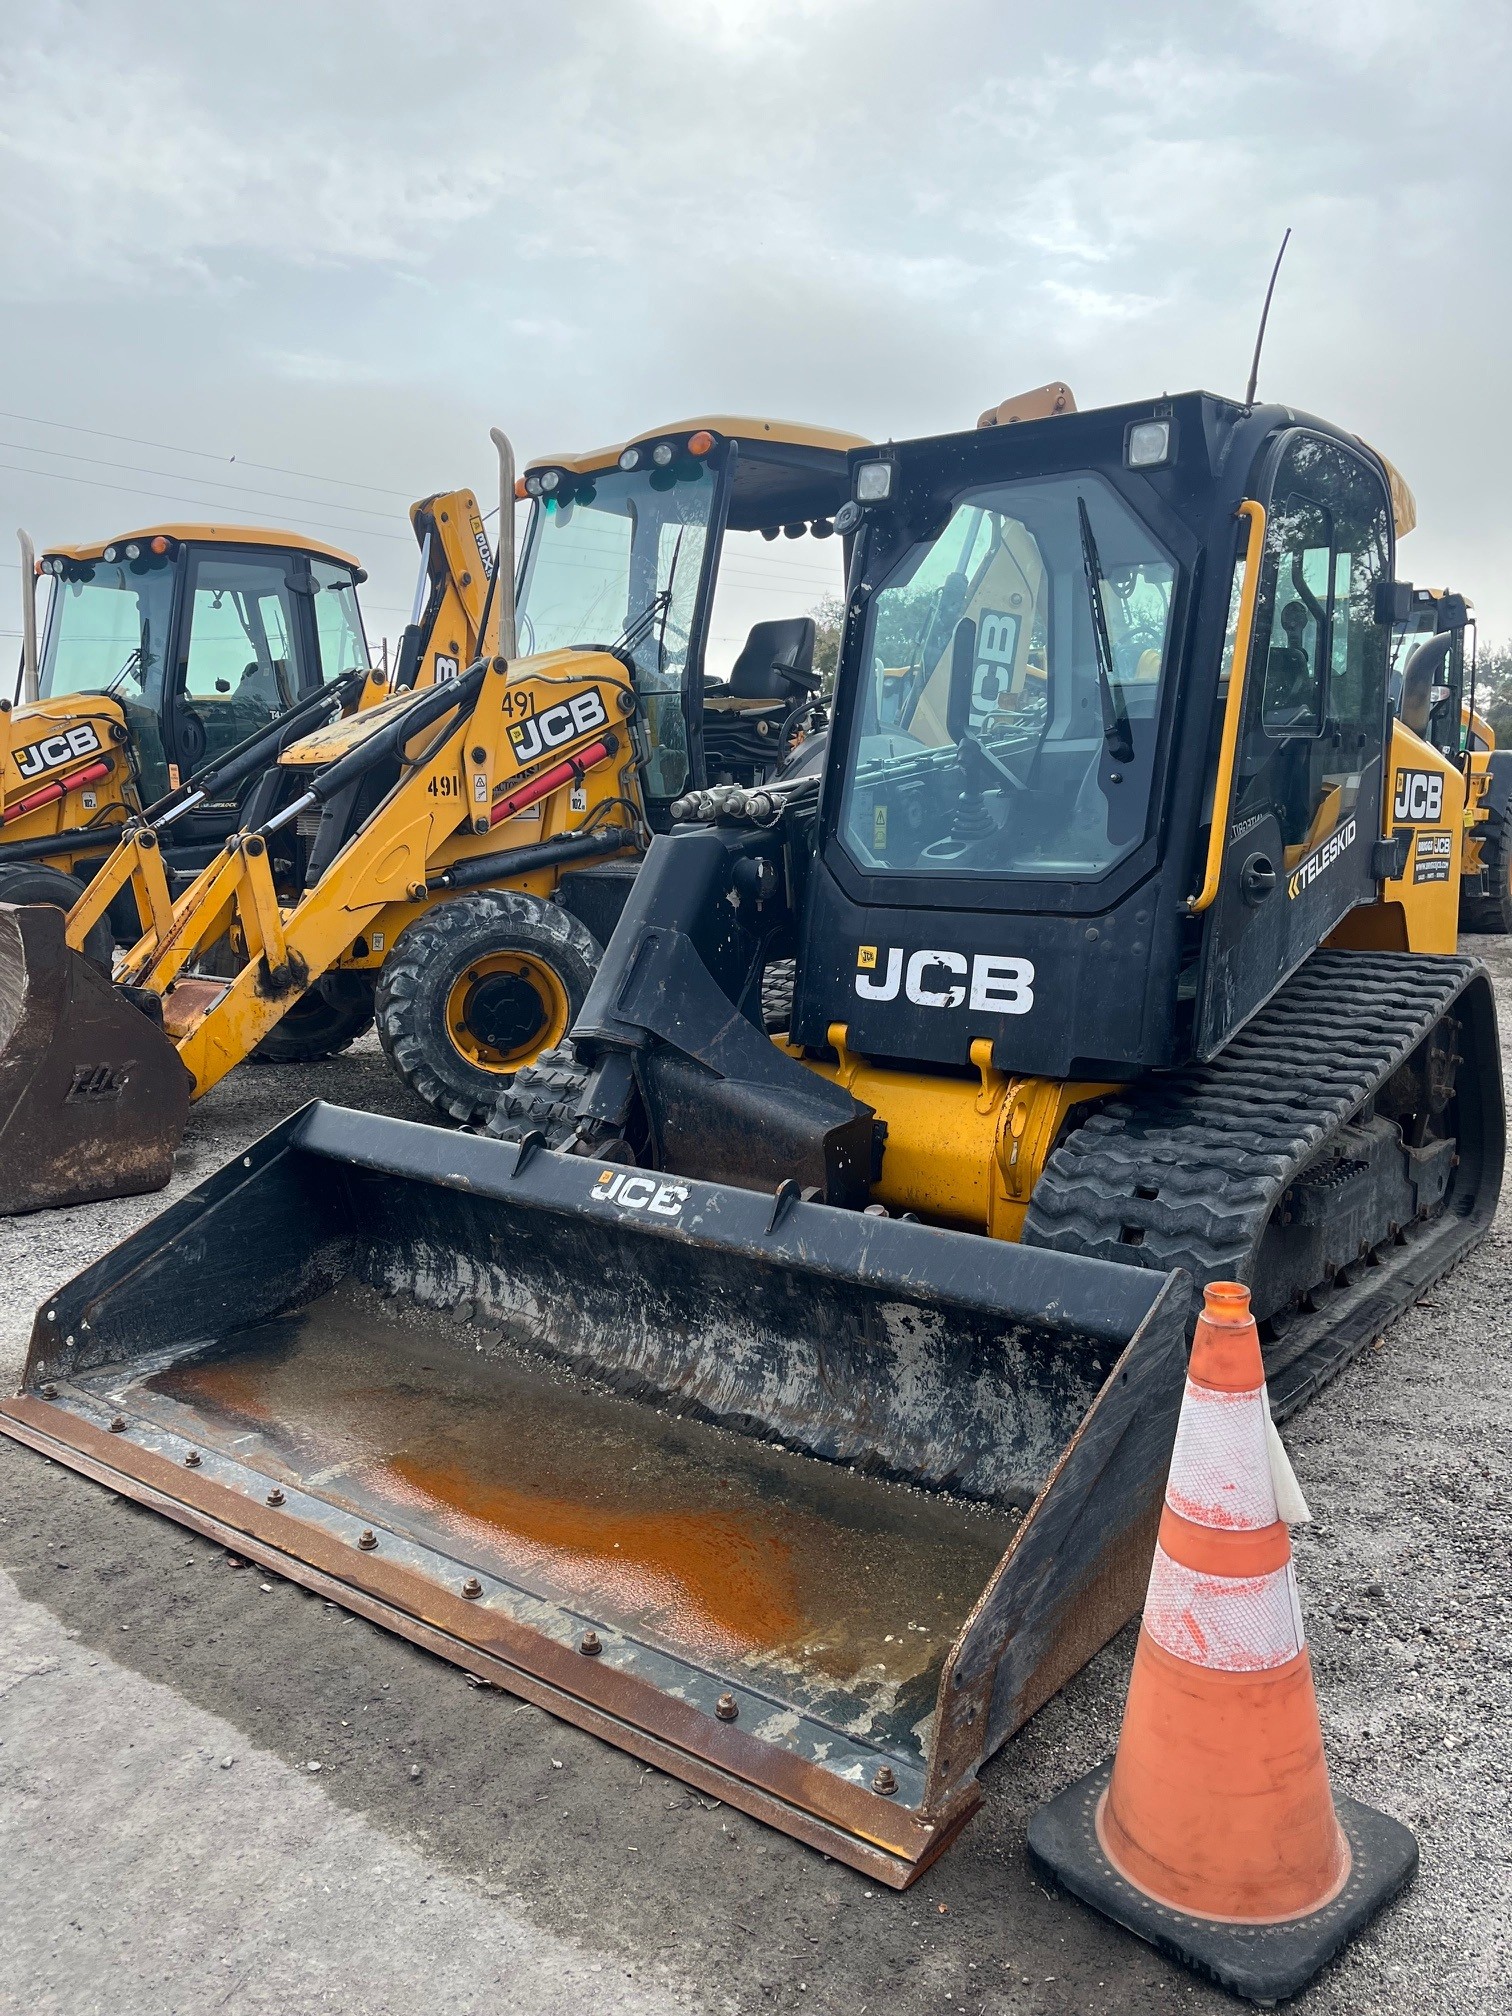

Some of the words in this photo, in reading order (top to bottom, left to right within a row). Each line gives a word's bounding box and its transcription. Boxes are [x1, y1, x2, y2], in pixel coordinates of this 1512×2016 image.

[502, 691, 535, 718] 491
[515, 691, 606, 760] JCB
[20, 725, 99, 776] JCB
[428, 776, 458, 796] 491
[1395, 773, 1443, 819] JCB
[1300, 820, 1356, 889] TELESKID
[1434, 837, 1450, 853] JCB
[855, 947, 1036, 1015] JCB
